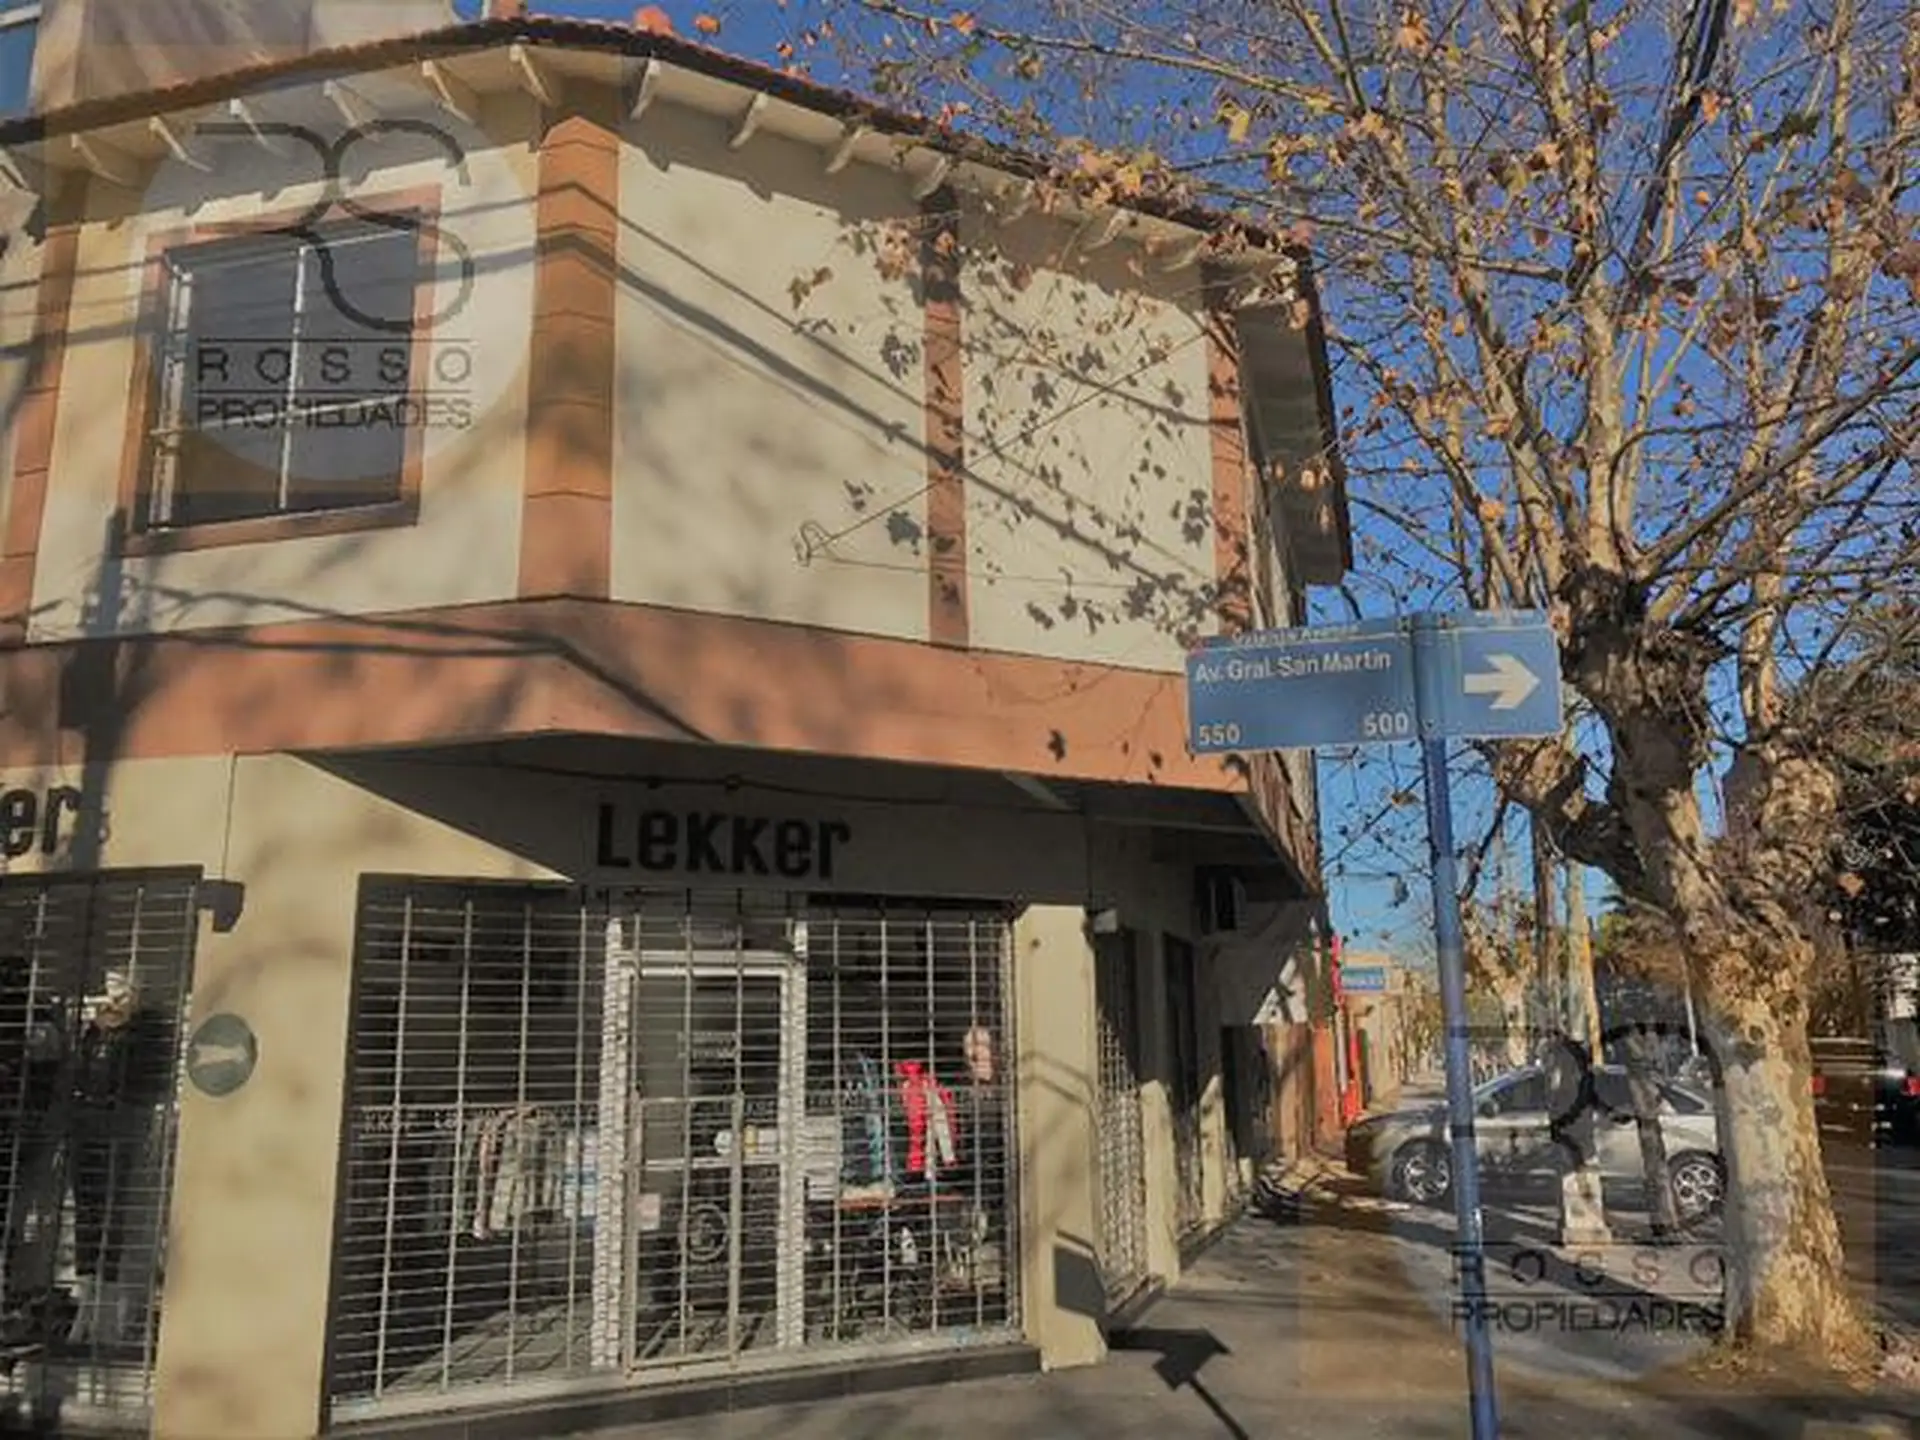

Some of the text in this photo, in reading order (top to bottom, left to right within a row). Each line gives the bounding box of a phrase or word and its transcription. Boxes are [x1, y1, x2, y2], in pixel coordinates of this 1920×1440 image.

[1195, 662, 1226, 683] Av.
[1276, 654, 1320, 678] San
[1199, 722, 1241, 746] 550
[597, 803, 850, 881] Lekker
